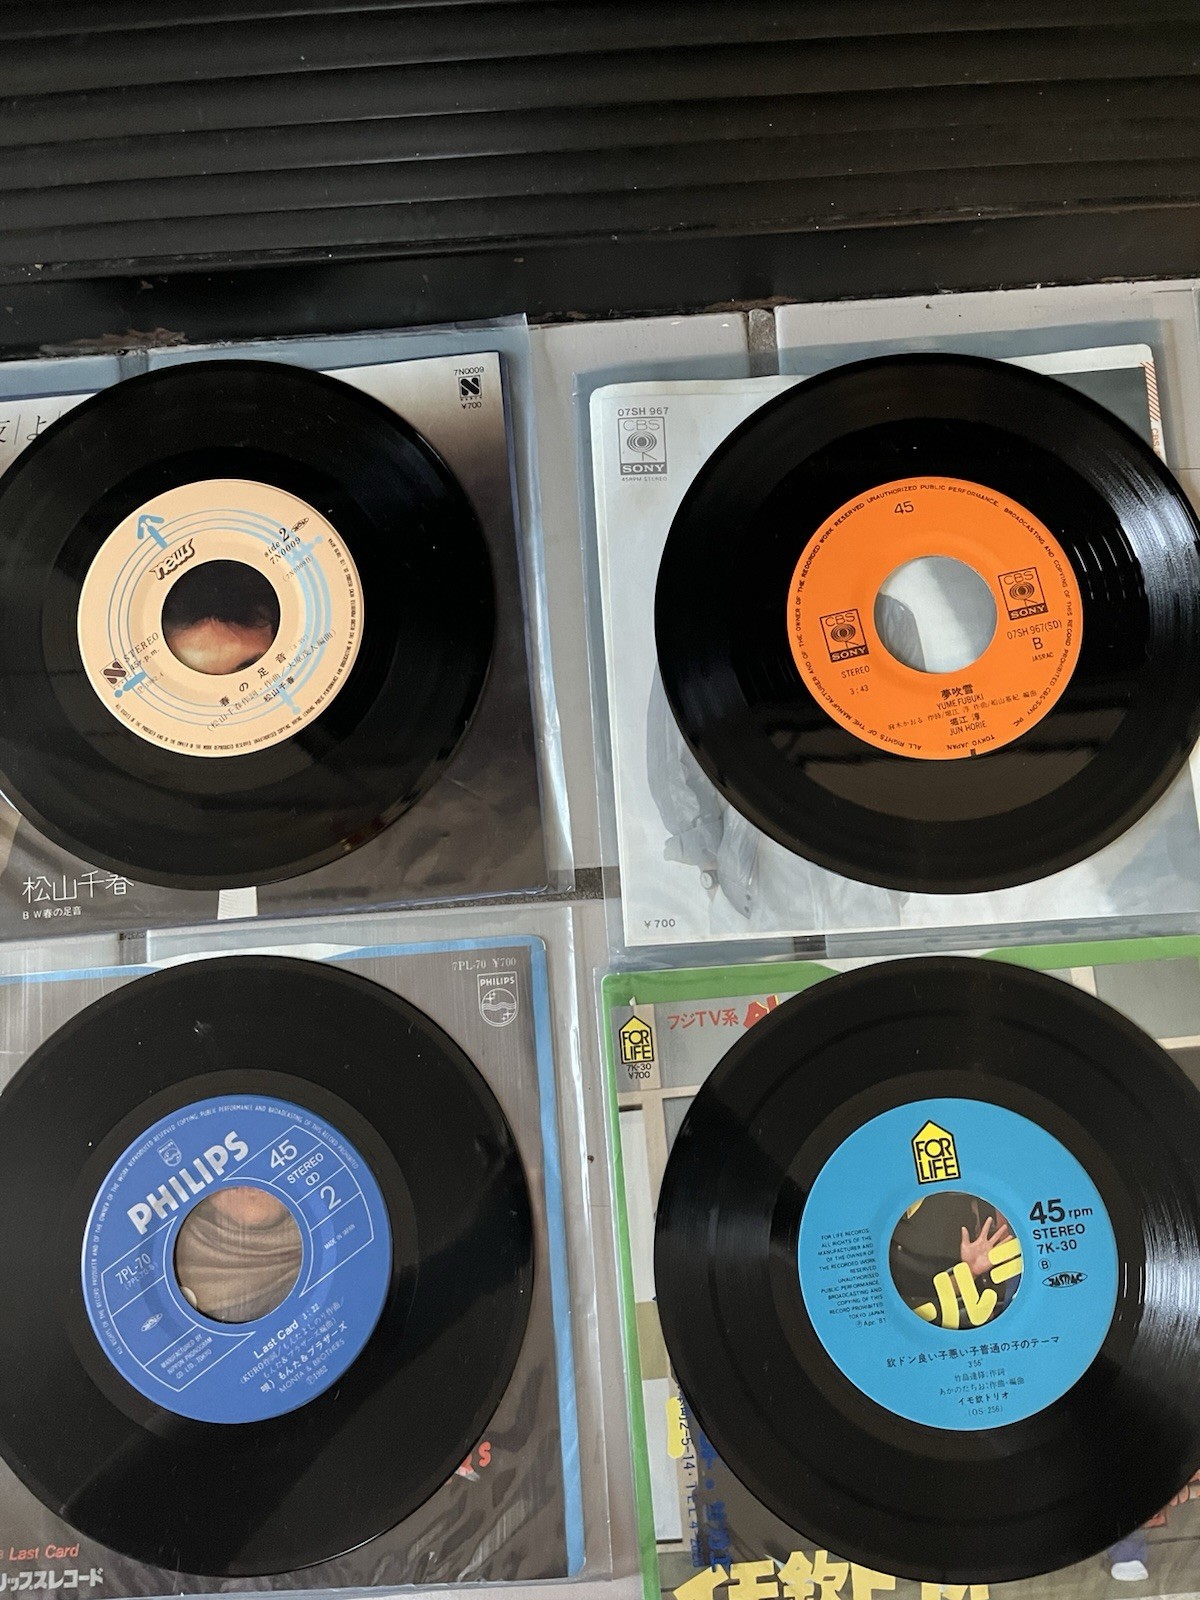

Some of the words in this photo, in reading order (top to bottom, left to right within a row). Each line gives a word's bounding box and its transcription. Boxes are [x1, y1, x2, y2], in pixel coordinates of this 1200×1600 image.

[618, 407, 646, 416] 07SH
[649, 407, 669, 415] 967
[623, 419, 660, 431] CBS
[622, 464, 664, 473] SONY
[867, 485, 917, 505] UNAUTHORIZED
[834, 502, 865, 528] RESERVED
[894, 500, 914, 514] 45
[1003, 505, 1046, 544] BROADCASTING
[264, 541, 281, 557] side
[279, 527, 290, 542] 2
[819, 527, 834, 544] WORK
[1043, 544, 1055, 558] AND
[1003, 571, 1034, 585] CBS
[1051, 559, 1068, 587] COPYING
[825, 612, 855, 627] CBS
[1010, 605, 1045, 619] SONY
[1006, 628, 1028, 640] 07SH
[124, 632, 159, 663] STEREO
[1032, 637, 1043, 650] B
[832, 647, 866, 661] SONY
[841, 665, 870, 679] STEREO
[812, 675, 852, 720] MANUFACTURER
[941, 683, 974, 700] 夢吹雪
[936, 699, 957, 711] YUME
[957, 693, 985, 706] FUBUKI
[852, 718, 866, 730] THE
[867, 727, 877, 736] OF
[949, 727, 964, 736] JUN
[964, 720, 987, 732] HORIE
[879, 733, 904, 746] RIGHTS
[946, 742, 969, 750] JAPAN
[972, 734, 995, 746] TOKYO
[22, 870, 134, 903] 松山千春
[480, 976, 515, 986] PHILIPS
[667, 1008, 739, 1030] フジTV系
[622, 1030, 649, 1046] FOR
[624, 1044, 651, 1060] LIFE
[627, 1063, 651, 1071] 7K-30
[271, 1139, 298, 1169] 45
[916, 1138, 952, 1160] FOR
[287, 1153, 324, 1184] STEREO
[919, 1157, 956, 1180] LIFE
[127, 1131, 249, 1235] PHILIPS
[320, 1185, 342, 1210] 2
[1029, 1199, 1065, 1224] 45
[1068, 1207, 1093, 1219] rpm
[1033, 1223, 1085, 1240] STEREO
[818, 1246, 860, 1255] MANUFACTURER
[1037, 1239, 1077, 1254] 7K-30
[115, 1253, 151, 1284] 7PL-70
[850, 1265, 876, 1273] RESERVED
[828, 1291, 869, 1300] BROADCASTING
[253, 1338, 277, 1359] Last
[277, 1319, 299, 1340] Card
[886, 1336, 1060, 1368] 欽ドン良い子悪い子普通の子のテーマ
[958, 1391, 1009, 1405] イモ欽トリオ
[9, 1547, 39, 1560] Last
[45, 1543, 80, 1559] Card
